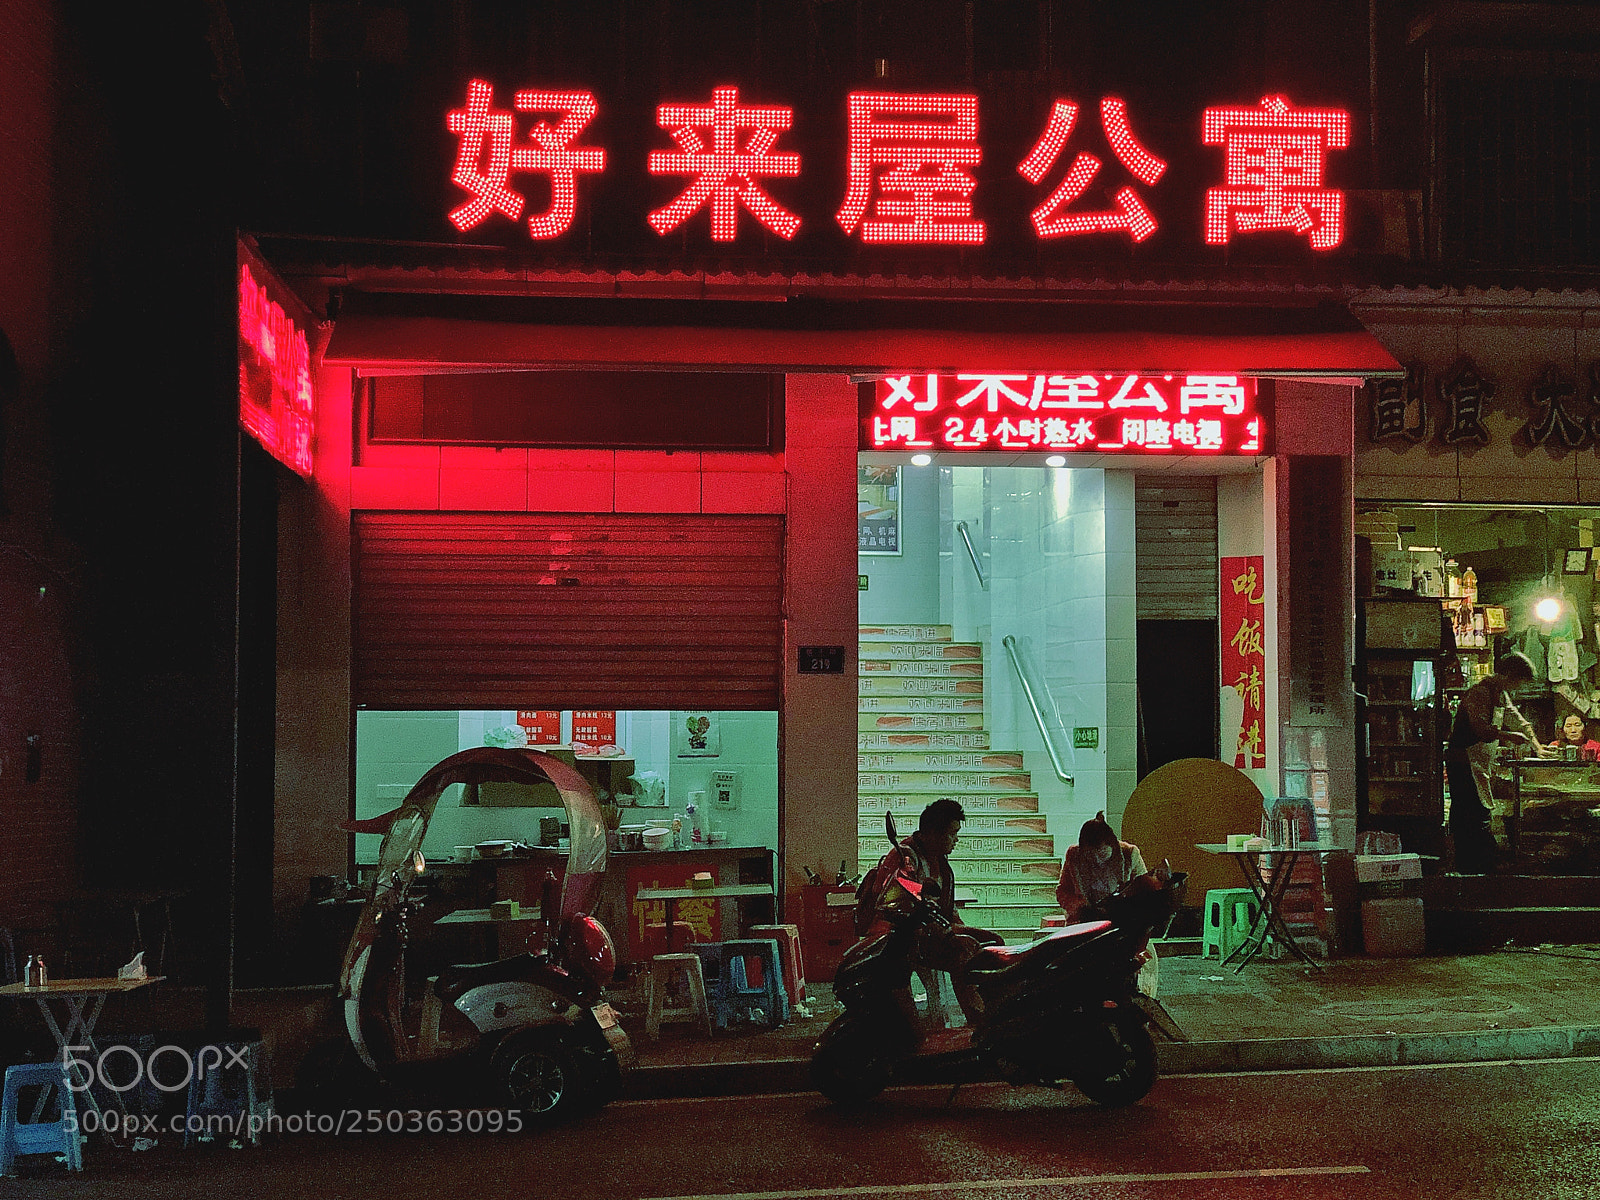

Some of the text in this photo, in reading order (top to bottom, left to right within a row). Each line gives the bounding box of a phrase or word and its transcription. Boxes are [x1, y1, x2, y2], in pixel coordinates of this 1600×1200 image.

[446, 78, 1351, 250] 好来屋公寓
[945, 416, 1095, 445] 24小时热水
[1122, 418, 1223, 445] 闭路电视
[891, 645, 943, 658] 欢迎光临
[897, 663, 951, 674] 欢迎光临
[902, 680, 957, 692] 欢迎光临
[908, 699, 963, 710] 欢迎光临
[925, 755, 982, 766] 欢迎光临
[932, 774, 990, 787] 欢迎光临
